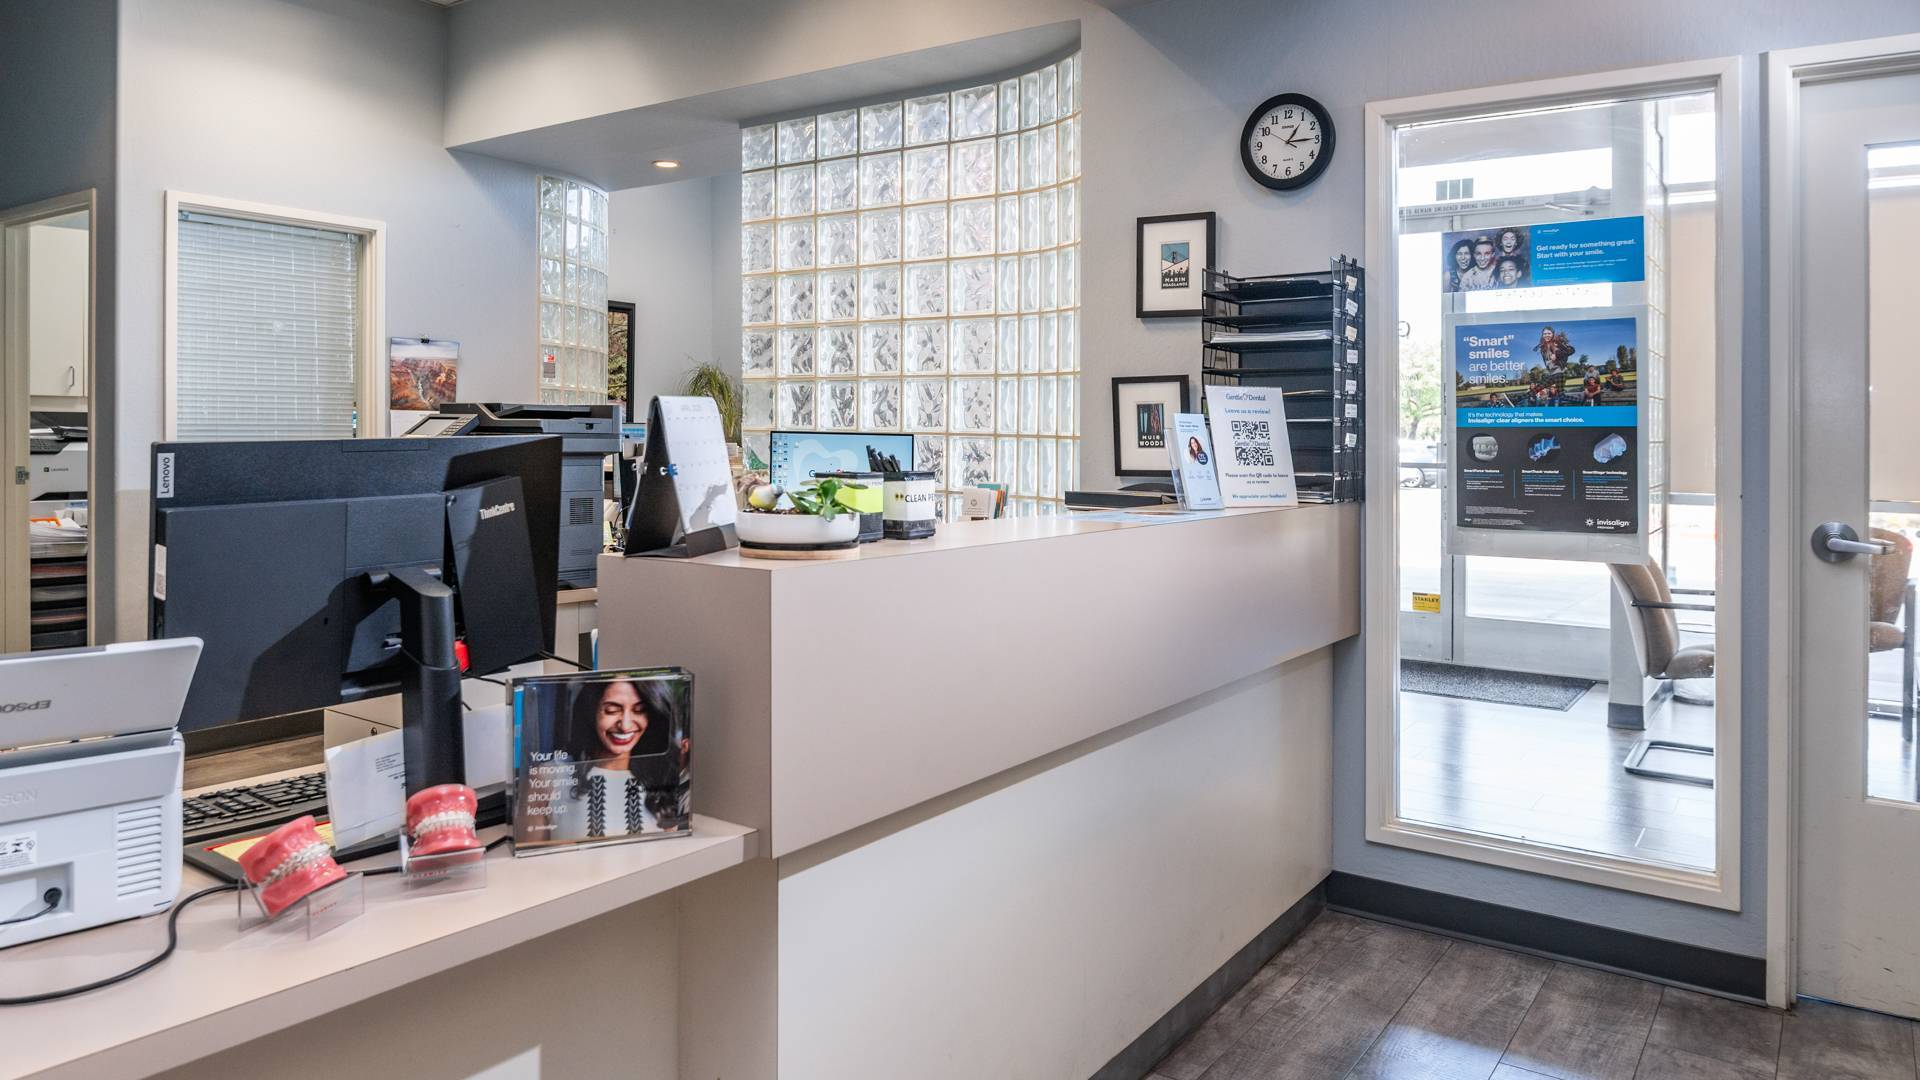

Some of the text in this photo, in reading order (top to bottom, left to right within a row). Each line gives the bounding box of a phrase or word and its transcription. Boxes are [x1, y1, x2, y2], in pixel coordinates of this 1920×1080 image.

[1271, 115, 1279, 125] 11
[1284, 109, 1293, 120] 12
[1300, 111, 1305, 121] 1
[1310, 121, 1316, 130] 2
[1261, 126, 1271, 137] 10
[1314, 135, 1320, 144] 3
[1256, 141, 1263, 151] 9
[1261, 155, 1267, 164] 8
[1309, 150, 1315, 159] 4
[1272, 164, 1278, 174] 7
[1285, 166, 1291, 176] 6
[1299, 162, 1305, 171] 5
[1536, 238, 1636, 252] Get ready for something great.
[1536, 248, 1605, 259] Start with your smile.
[1468, 348, 1510, 359] smiles
[1468, 360, 1526, 372] are better
[1468, 373, 1509, 384] smiles.
[160, 456, 170, 494] Lenovo
[904, 494, 927, 503] CLEAN
[479, 502, 516, 520] ThinkCentre
[1596, 518, 1630, 528] invisalign
[0, 699, 52, 713] EPSO
[530, 750, 569, 761] Your life
[528, 764, 577, 775] is moving.
[529, 776, 579, 789] Your smile
[527, 791, 561, 802] should
[527, 805, 553, 816] keep
